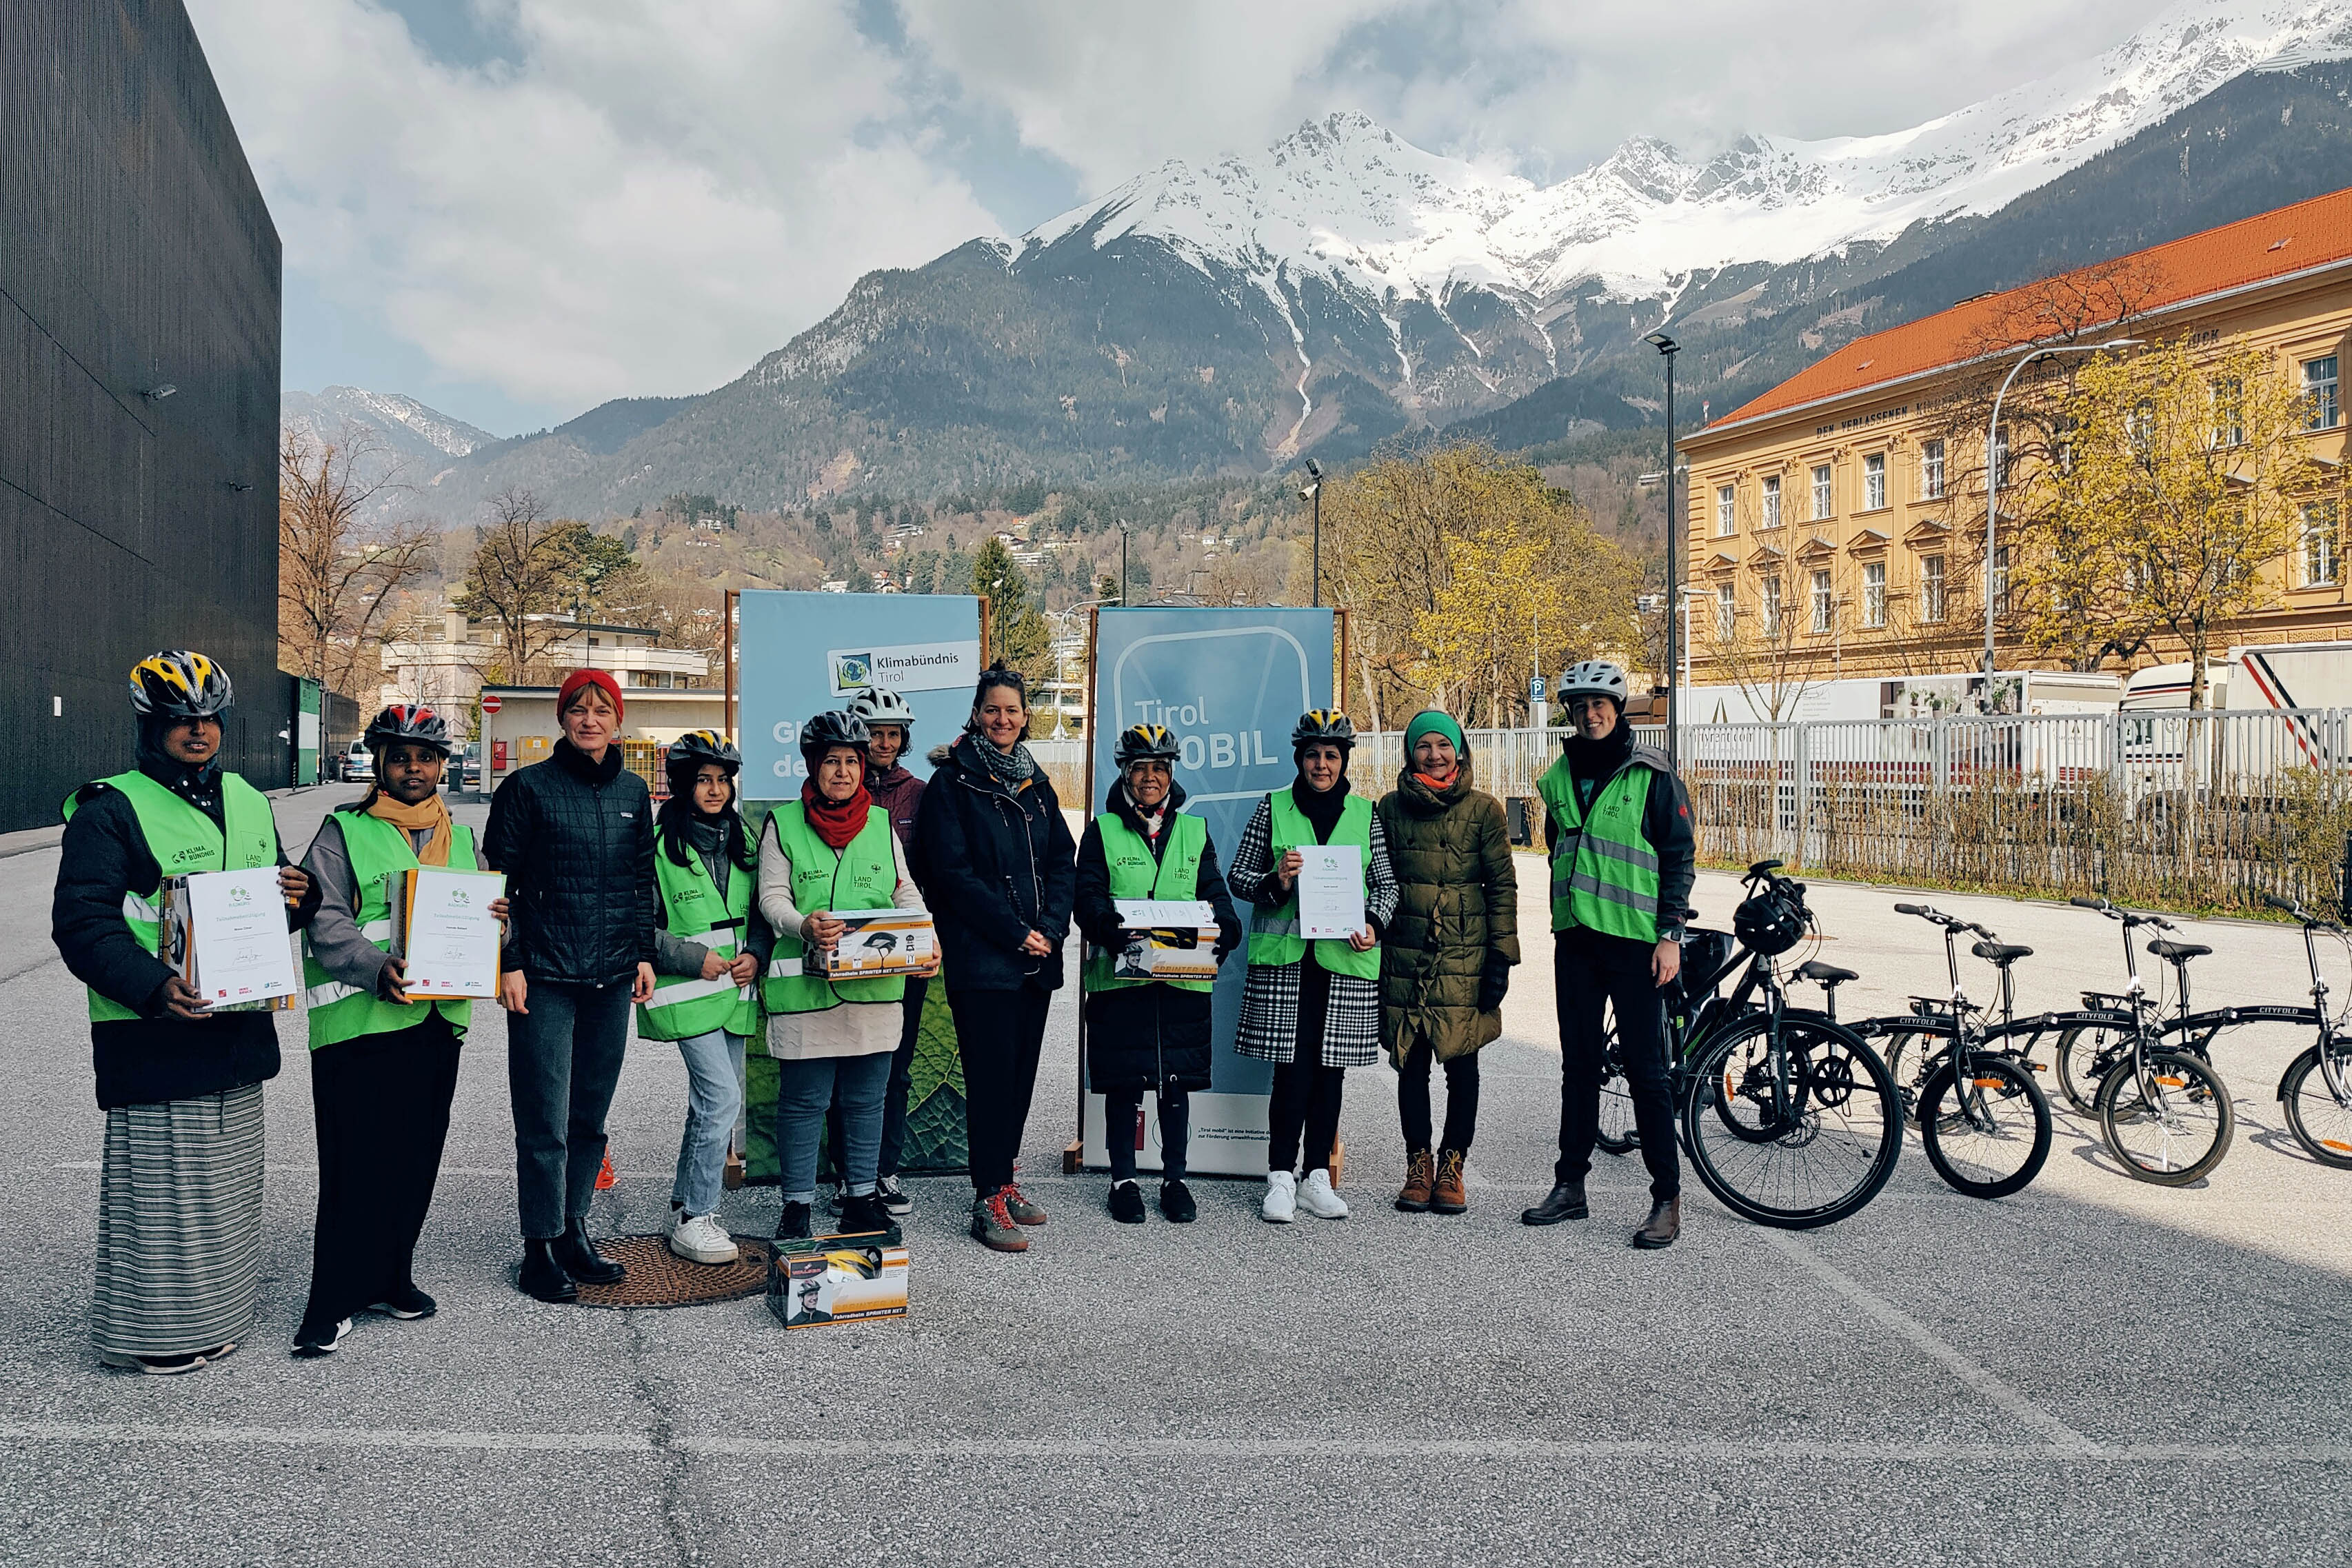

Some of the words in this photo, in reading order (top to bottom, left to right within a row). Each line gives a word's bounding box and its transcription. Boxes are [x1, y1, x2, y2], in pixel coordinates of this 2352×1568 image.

[1816, 424, 1834, 439] DEN
[1842, 405, 1908, 432] VERLASSENEN
[877, 652, 958, 669] Klimabündnis
[878, 671, 904, 683] Tirol
[1534, 683, 1542, 694] P
[1134, 696, 1209, 727] Tirol
[1172, 730, 1278, 771] OBIL
[1602, 810, 1618, 818] TIROL
[186, 845, 205, 854] KLIMA
[188, 850, 215, 861] BÜNDNIS
[245, 854, 261, 863] LAND
[1900, 1017, 1936, 1026] CITYFOLD
[2076, 1012, 2114, 1020] CITYFOLD
